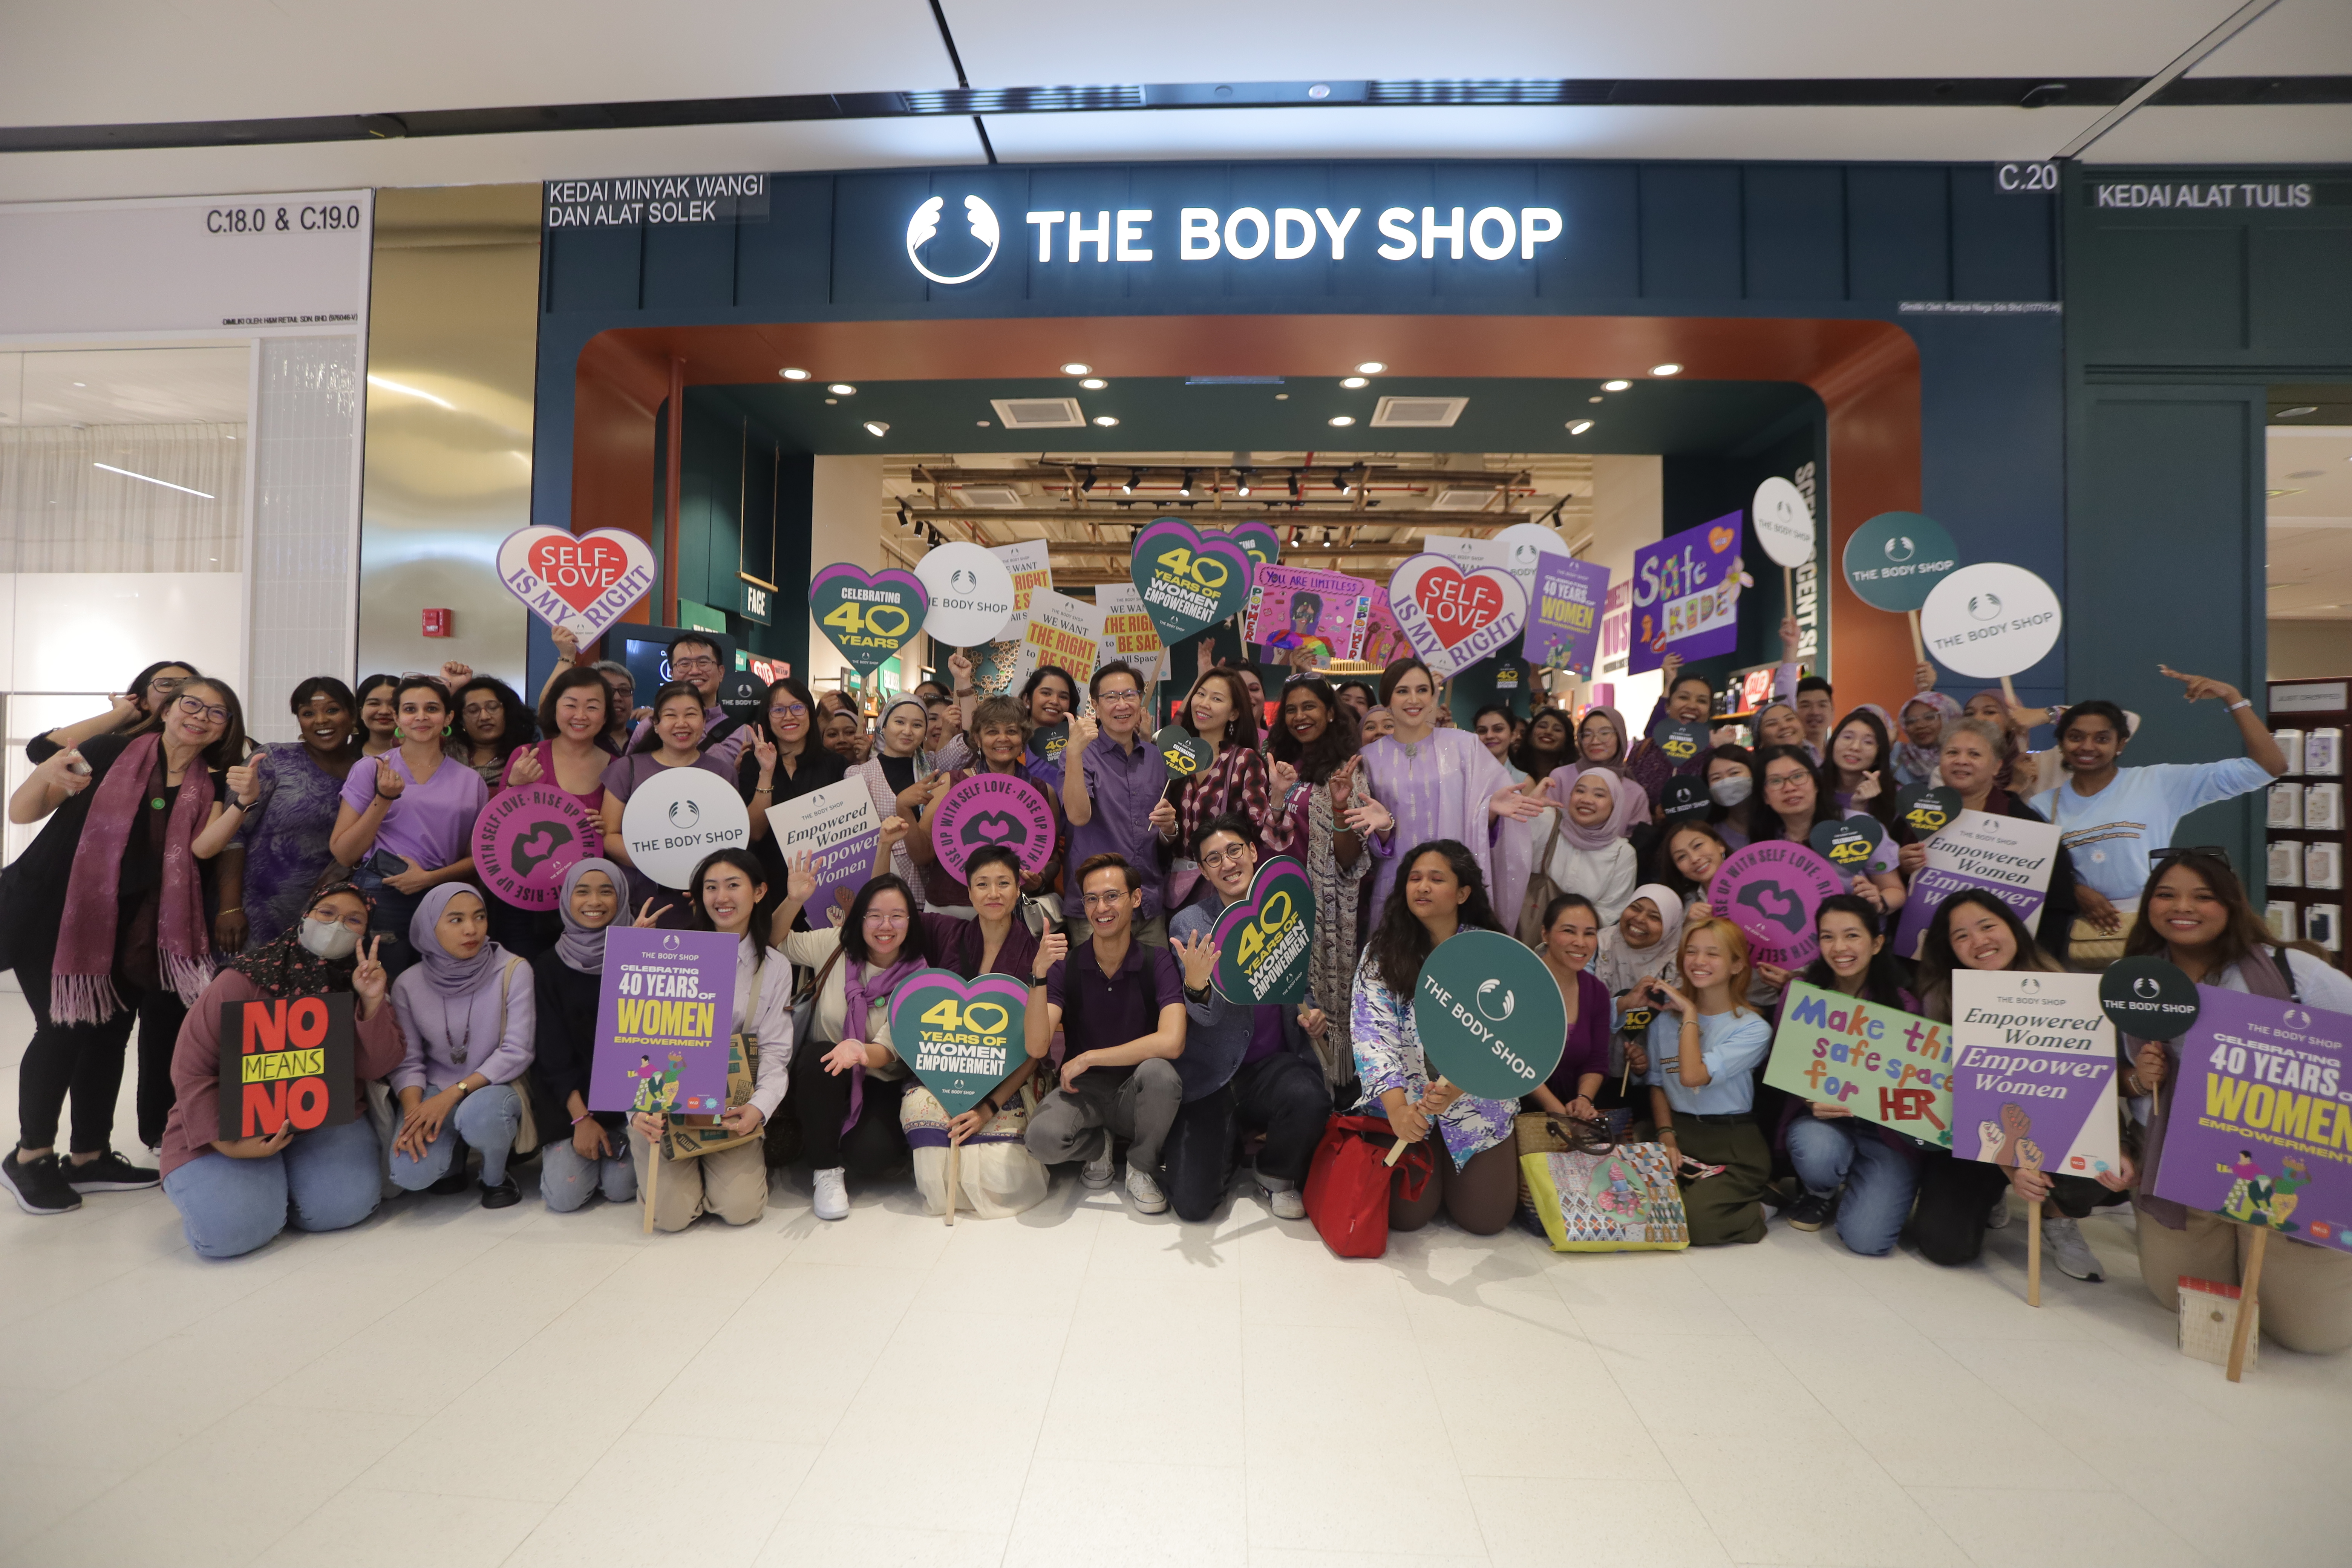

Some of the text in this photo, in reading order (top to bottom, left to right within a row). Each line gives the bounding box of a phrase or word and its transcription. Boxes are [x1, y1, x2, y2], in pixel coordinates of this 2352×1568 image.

[550, 174, 763, 203] KEDAI MINYAK WANGI
[1999, 164, 2058, 190] C.20
[2098, 184, 2311, 207] KEDAI ALAT TULIS
[207, 205, 359, 233] C.18.0 & C.19.0
[549, 200, 716, 226] DAN ALAT SOLEK
[1026, 206, 1563, 263] THE BODY SHOP
[541, 546, 620, 567] SELF-
[1012, 562, 1037, 572] WANT
[1157, 547, 1228, 588] 40
[1853, 559, 1954, 581] THE BODY SHOP
[541, 567, 615, 588] LOVE
[1015, 571, 1047, 591] RIGHT
[1155, 568, 1221, 599] YEARS OF
[1267, 571, 1357, 592] YOU ARE LIMITLESS
[1543, 580, 1557, 596] 40
[1558, 584, 1587, 602] YEARS
[1633, 545, 1707, 608] Safe
[507, 565, 652, 628] IS MY RIGHT
[748, 587, 765, 616] FACE
[841, 587, 900, 603] CELEBRATING
[943, 598, 1008, 613] BODY SHOP
[1144, 587, 1214, 623] EMPOWERMENT
[1151, 577, 1218, 610] WOMEN
[1426, 577, 1496, 606] SELF-
[824, 602, 910, 636] 40
[1110, 605, 1125, 613] WE
[1244, 587, 1262, 641] POWHER
[1423, 597, 1489, 629] LOVE
[1541, 595, 1595, 629] WOMEN
[1043, 614, 1089, 636] WE WANT
[1105, 617, 1125, 634] THE
[1348, 597, 1369, 660] EMPOWHER
[1393, 594, 1418, 621] IS
[1408, 621, 1442, 656] MY
[1448, 612, 1519, 667] RIGHT
[1538, 619, 1591, 634] EMPOWERMENT
[1934, 612, 2053, 650] THE BODY SHOP
[838, 634, 899, 649] YEARS
[1026, 649, 1035, 658] to
[1030, 623, 1095, 660] THE RIGHT
[1118, 635, 1133, 652] BE
[1163, 750, 1196, 771] 40
[1166, 760, 1188, 775] YEARS
[813, 807, 828, 816] BODY
[829, 801, 844, 810] SHOP
[940, 781, 1047, 862] UP WITH SELF LOVE RISE UP WITH
[1905, 809, 1947, 825] 40
[481, 792, 580, 876] WITH SELF LOVE RISE UP
[787, 802, 867, 845] Empowered
[816, 821, 867, 847] Women
[632, 829, 743, 853] THE BODY SHOP
[1829, 840, 1873, 858] 40
[1926, 837, 2046, 870] Empowered
[1975, 834, 1995, 843] BODY
[1997, 838, 2018, 846] SHOP
[1726, 849, 1821, 878] WITH SELF LOVE
[1958, 858, 2030, 884] Women
[1237, 891, 1292, 966] 40
[1243, 911, 1298, 975] YEARS OF
[1248, 919, 1305, 986] WOMEN
[1253, 928, 1310, 1001] EMPOWERMENT
[620, 965, 699, 975] CELEBRATING
[619, 972, 642, 995] 40
[646, 974, 698, 998] YEARS
[617, 998, 715, 1037] WOMEN
[920, 999, 1009, 1034] 40
[1963, 1008, 2104, 1031] Empowered
[2103, 1000, 2196, 1014] THE BODY SHOP
[242, 997, 329, 1054] NO
[920, 1031, 1007, 1046] YEARS OF
[1424, 975, 1536, 1079] THE BODY SHOP
[1791, 995, 1952, 1063] Make thi
[2005, 1029, 2092, 1050] Women
[2247, 1023, 2343, 1049] THE BODY SHOP
[614, 1037, 712, 1047] EMPOWERMENT
[918, 1041, 1006, 1060] WOMEN
[1812, 1037, 1881, 1072] safe
[2213, 1033, 2341, 1067] CELEBRATING
[245, 1050, 321, 1081] MEANS
[915, 1054, 1005, 1076] EMPOWERMENT
[1962, 1047, 2109, 1078] Empower
[2209, 1044, 2340, 1096] 40 YEARS
[1803, 1060, 1946, 1131] for HER
[1975, 1073, 2068, 1099] Women
[242, 1077, 329, 1138] NO
[2206, 1072, 2352, 1151] WOMEN
[2199, 1117, 2352, 1164] EMPOWERMENT
